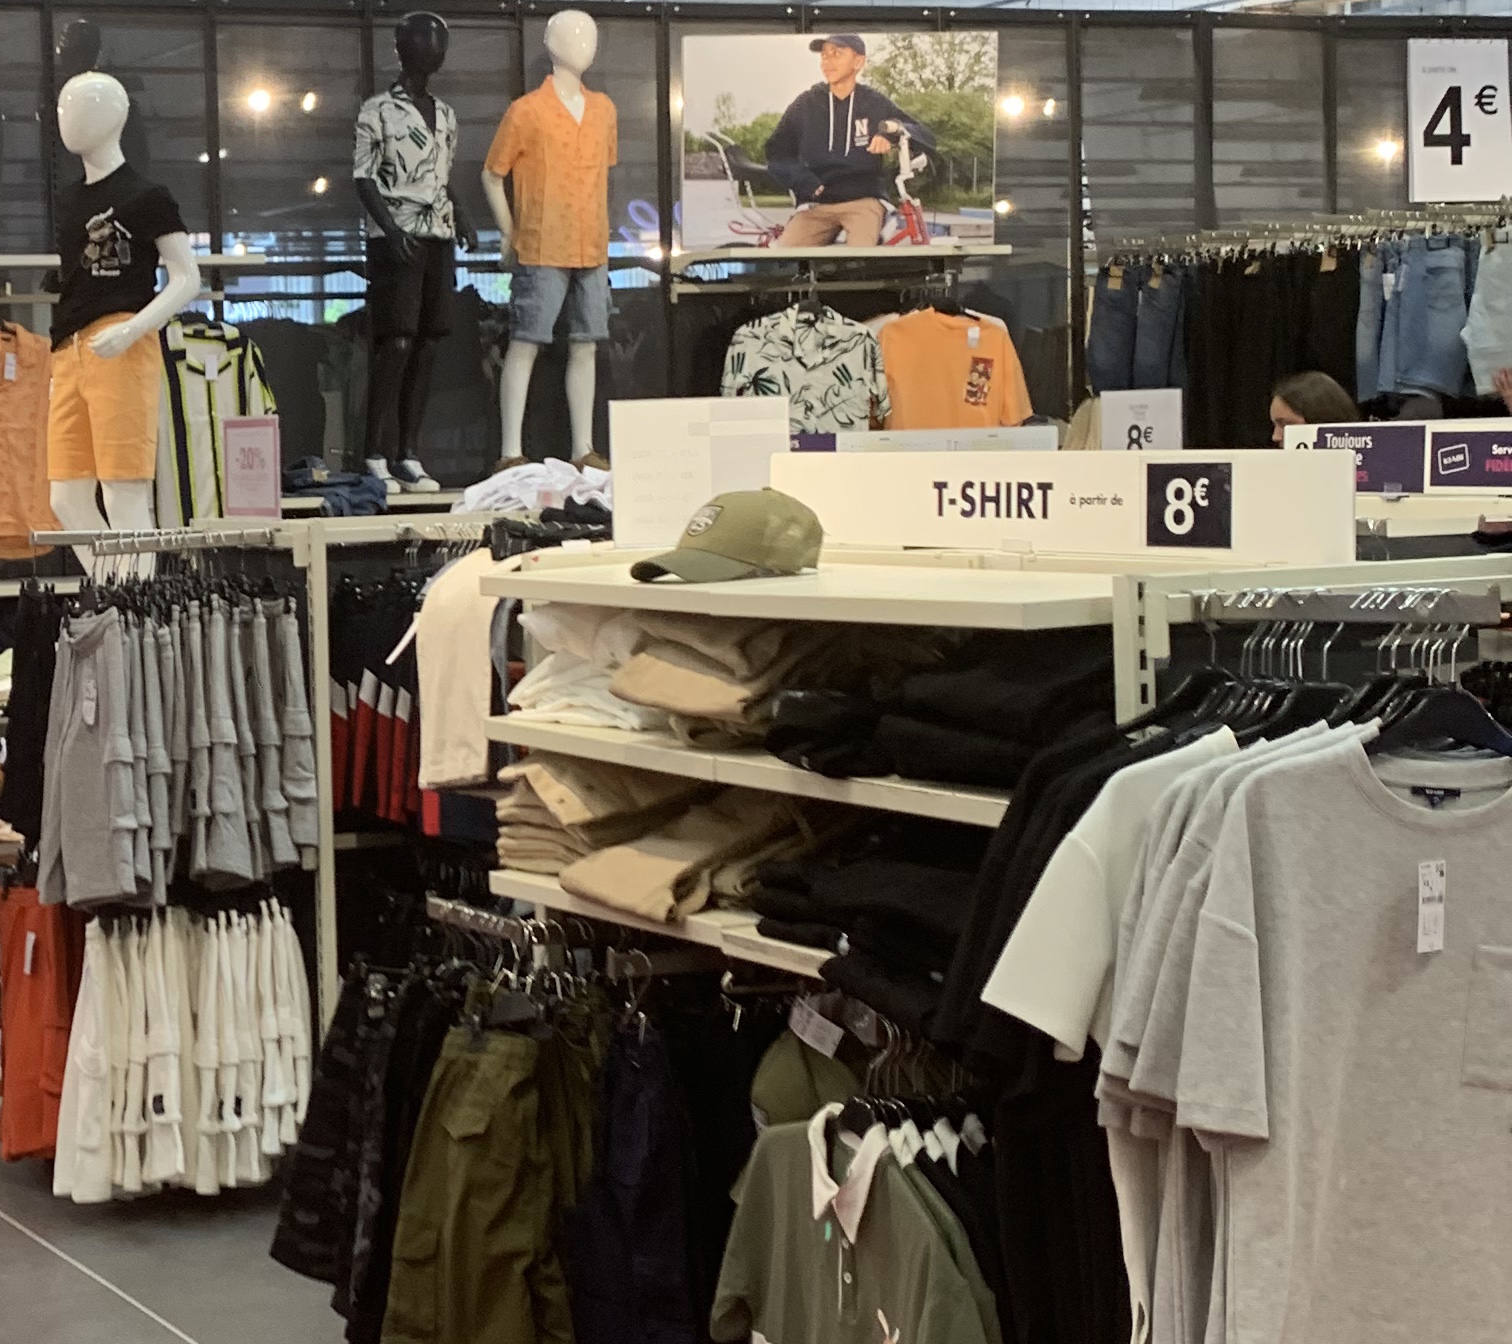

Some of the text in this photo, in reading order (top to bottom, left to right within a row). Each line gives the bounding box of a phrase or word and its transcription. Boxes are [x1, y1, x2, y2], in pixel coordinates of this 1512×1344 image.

[1423, 84, 1498, 165] 4€
[1324, 432, 1373, 449] Toujours
[932, 480, 1124, 519] T-SHIRT à partir de
[1163, 477, 1210, 535] 8€
